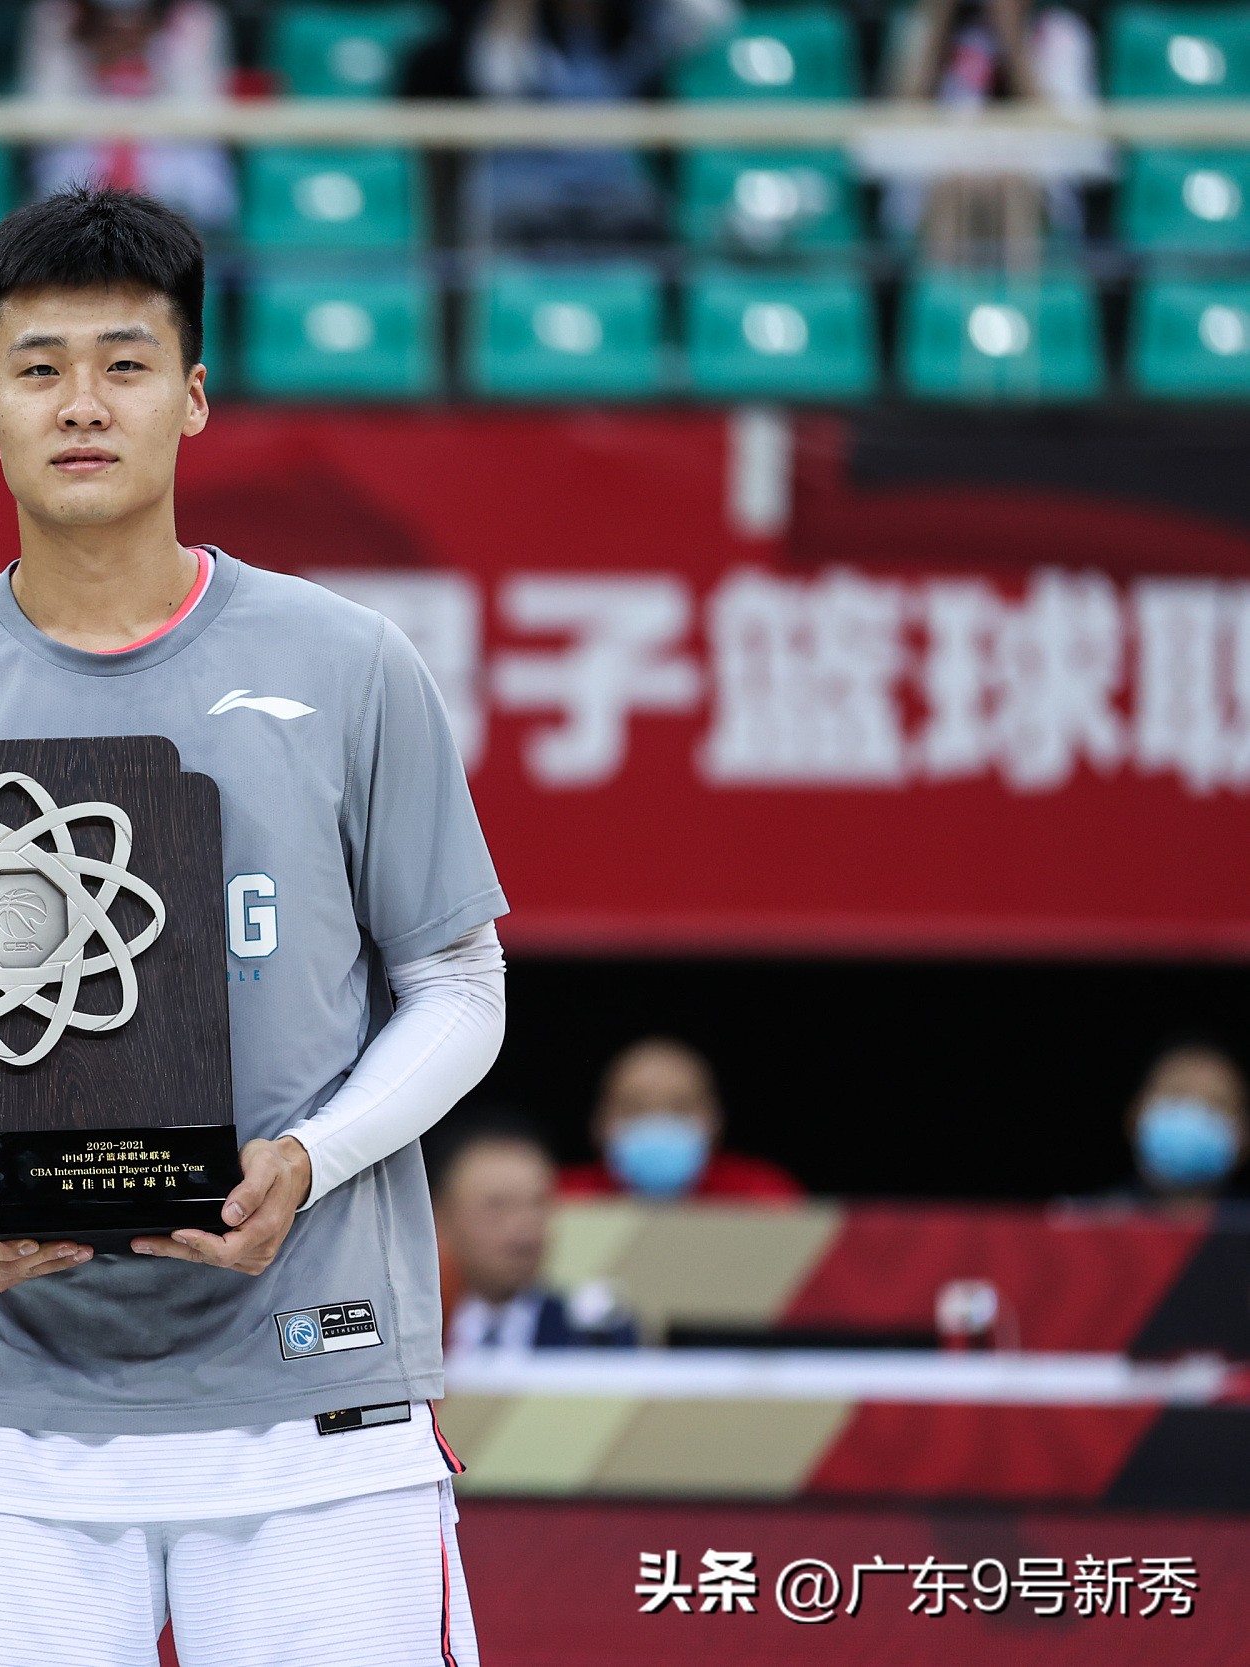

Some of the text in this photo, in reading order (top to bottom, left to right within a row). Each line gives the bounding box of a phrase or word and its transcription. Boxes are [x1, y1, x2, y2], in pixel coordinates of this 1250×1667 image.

[3, 941, 43, 952] CBA
[86, 1140, 144, 1151] 2020-2021
[61, 1150, 171, 1163] 中国男子篮球职业联赛
[30, 1162, 205, 1177] CBA International Player of the Year
[61, 1175, 177, 1191] 最佳国际球员
[347, 1308, 371, 1319] CBA
[324, 1324, 373, 1336] AUTHENTICS
